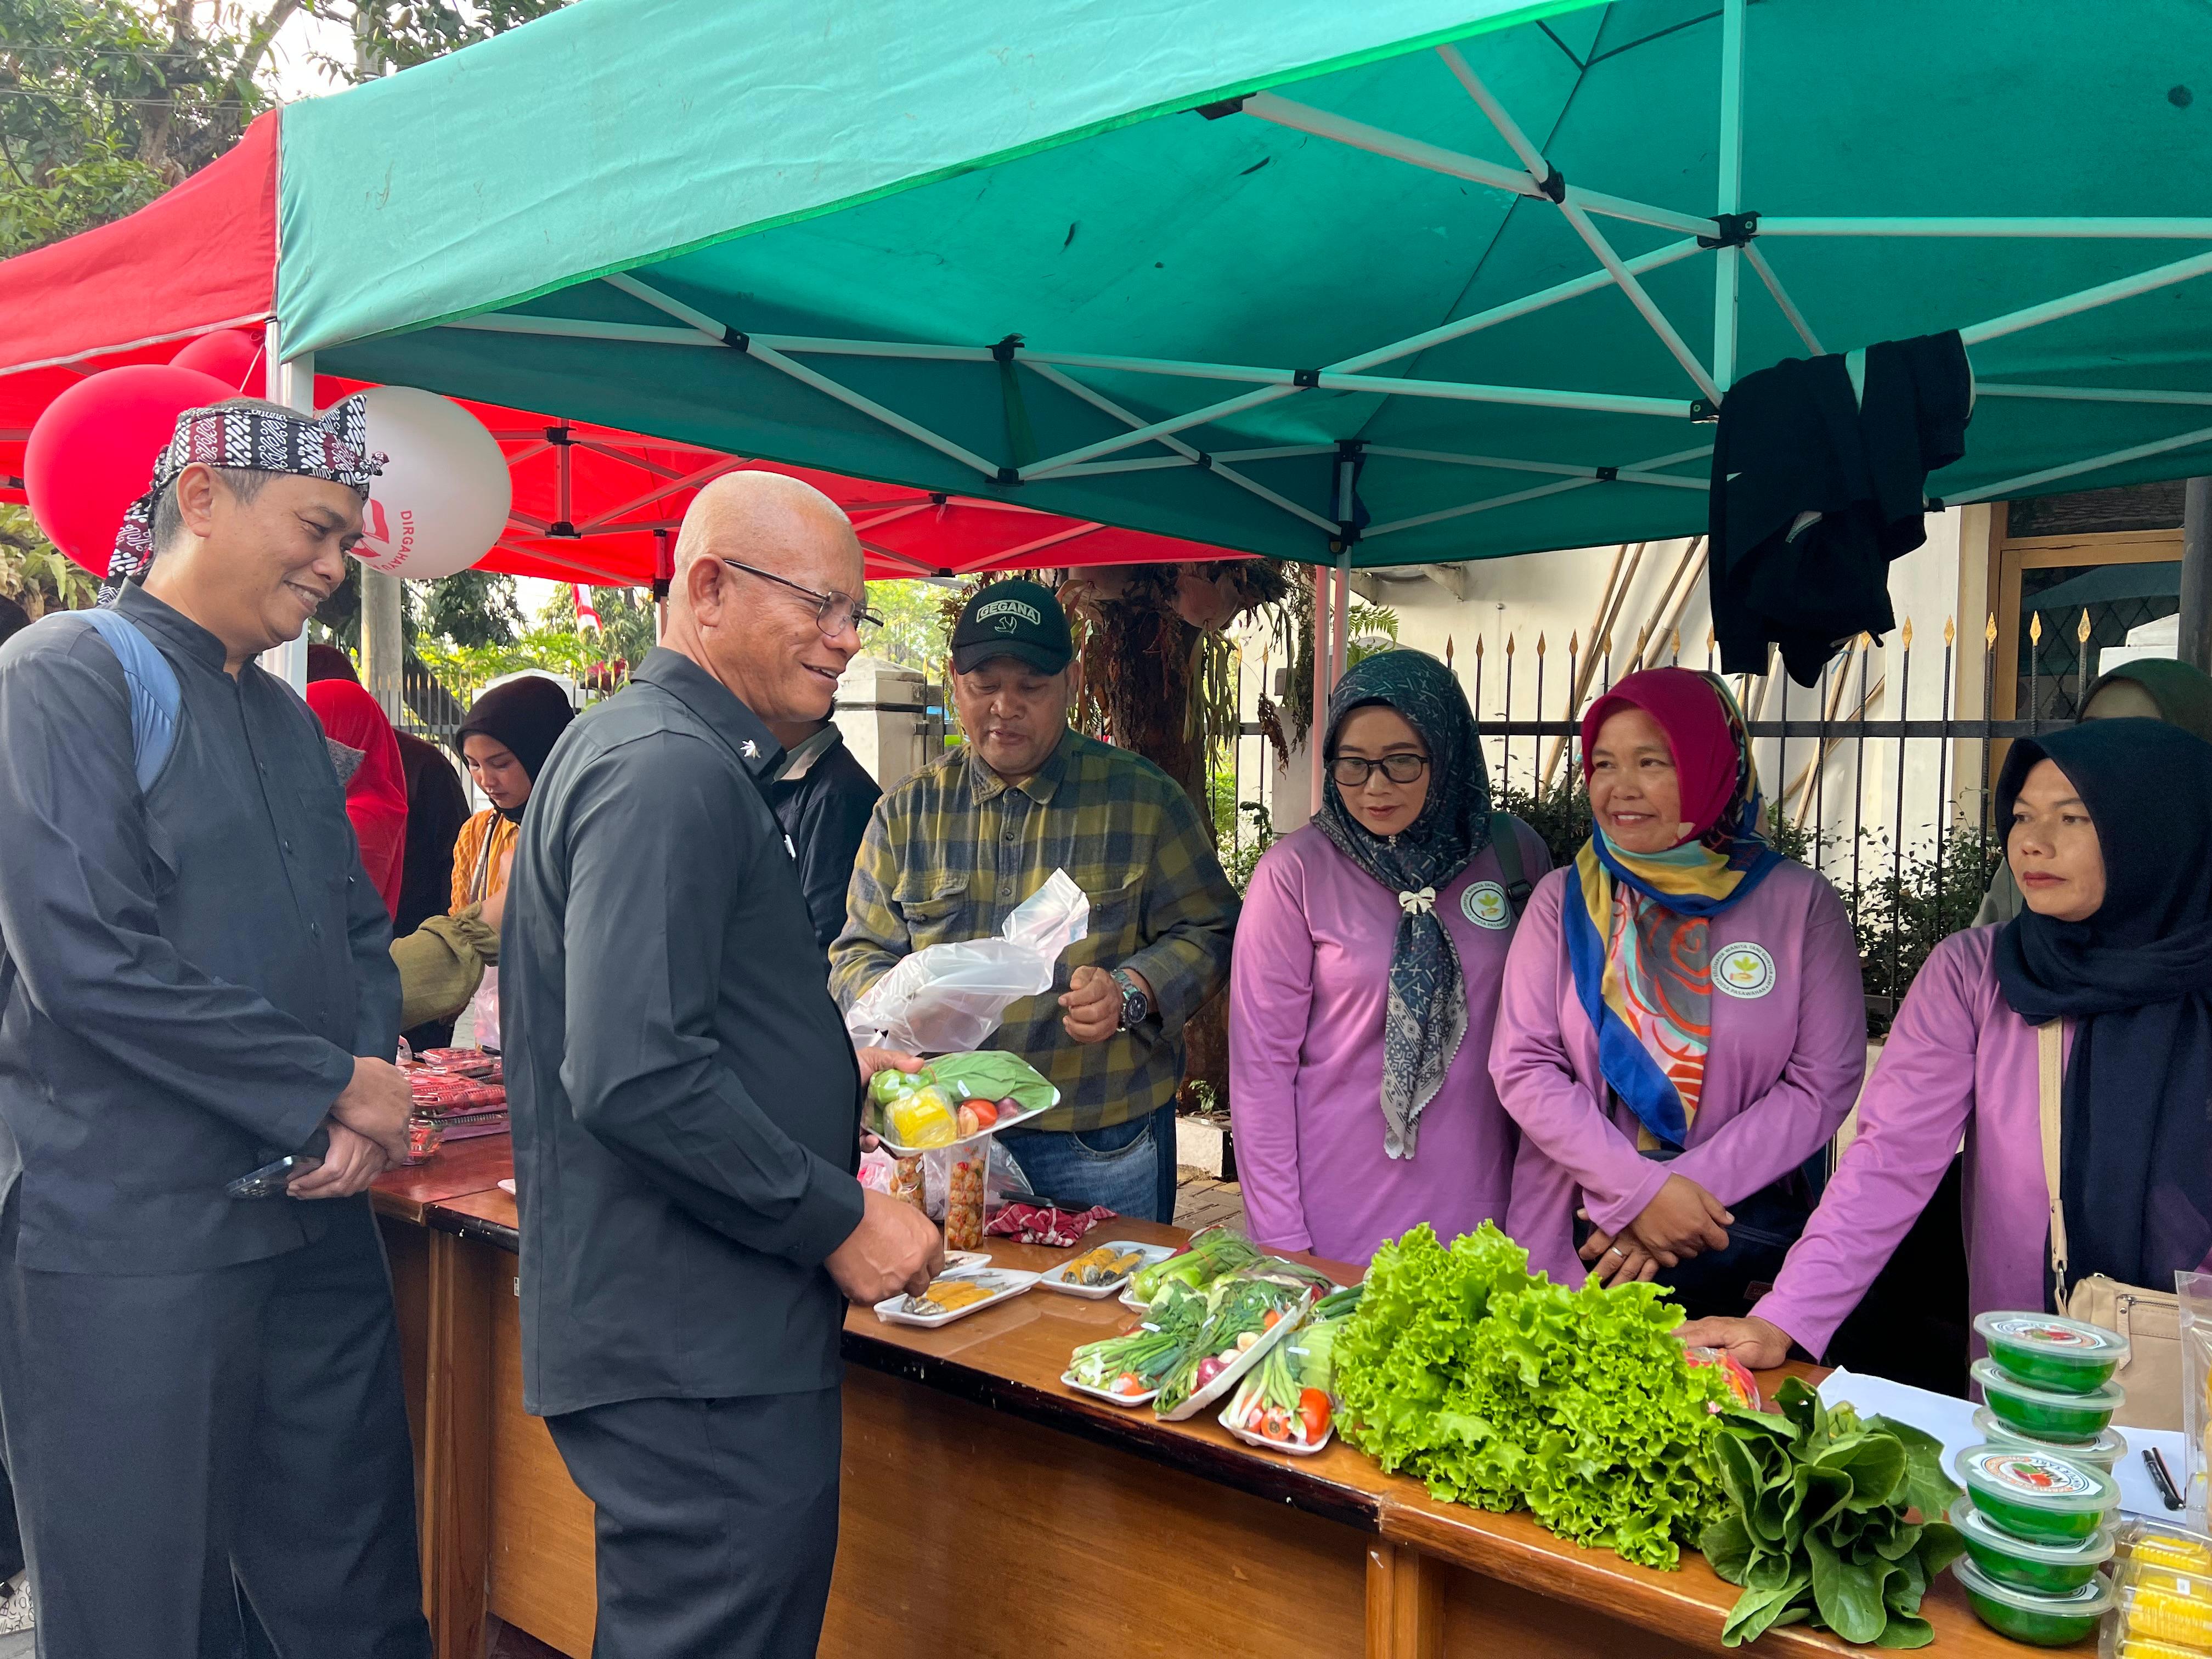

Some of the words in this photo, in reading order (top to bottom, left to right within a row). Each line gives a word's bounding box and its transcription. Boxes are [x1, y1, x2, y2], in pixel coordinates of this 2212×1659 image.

[381, 510, 414, 571] DIRGAHAYU
[980, 602, 1036, 620] GEGANA
[1749, 945, 1762, 953] TANI
[1762, 952, 1773, 974] GUNTUR
[1730, 987, 1766, 996] PASAWAHAN
